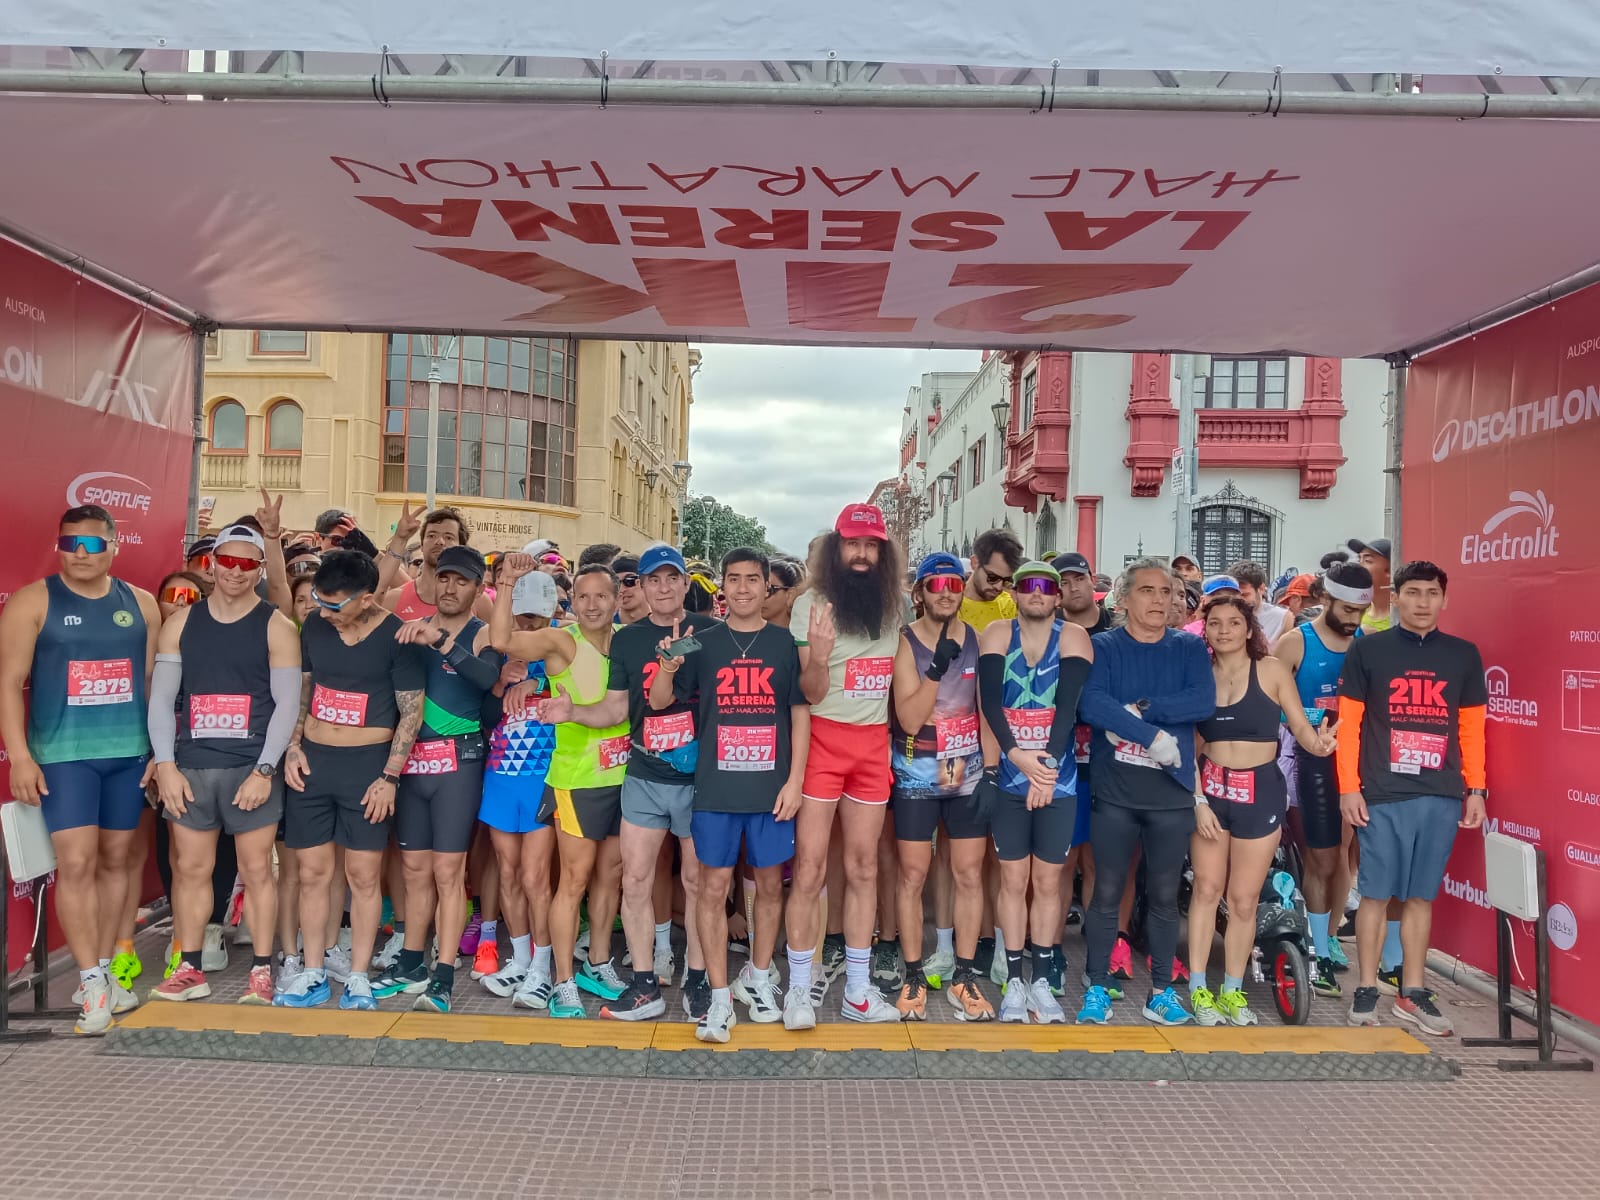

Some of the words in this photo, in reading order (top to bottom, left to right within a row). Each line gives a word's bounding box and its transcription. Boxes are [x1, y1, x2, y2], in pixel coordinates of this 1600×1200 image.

[330, 155, 980, 198] MARATHON
[1011, 168, 1301, 199] HALF
[354, 195, 1005, 253] SERENA
[1044, 210, 1252, 251] LA
[412, 245, 1194, 335] 21K
[5, 297, 46, 323] AUSPICIA
[1462, 384, 1600, 450] DECATHLON
[83, 486, 152, 511] SPORTLIFE
[476, 522, 507, 534] VINTAGE
[1460, 526, 1560, 565] Electrolit
[79, 678, 131, 695] 2879
[716, 667, 774, 694] 21K
[1489, 679, 1504, 695] LA
[717, 695, 731, 706] LA
[732, 695, 776, 706] SERENA
[1388, 677, 1448, 707] 21K
[316, 704, 361, 725] 2933
[1389, 704, 1404, 714] LA
[1405, 706, 1449, 717] SERENA
[1488, 697, 1538, 717] SERENA
[194, 713, 246, 729] 2009
[650, 730, 694, 750] 2774
[945, 730, 978, 750] 2842
[724, 745, 772, 761] 2037
[1398, 748, 1442, 768] 2310
[407, 757, 453, 774] 2092
[1205, 780, 1250, 802] 2733
